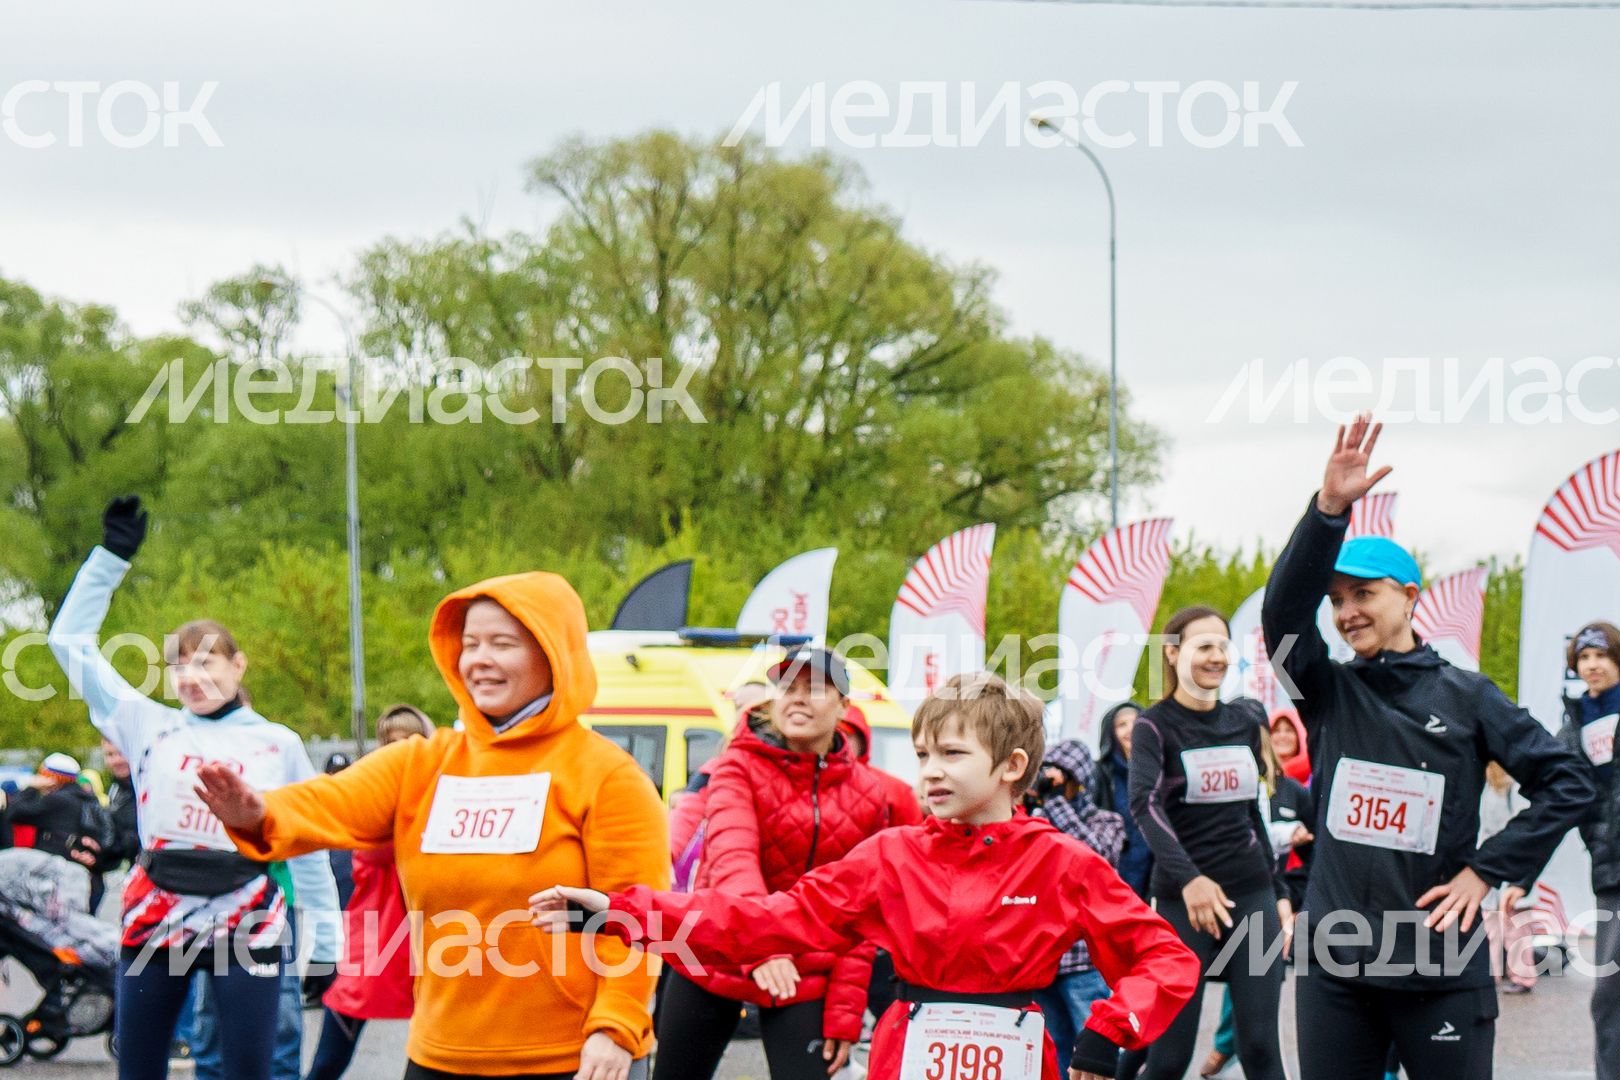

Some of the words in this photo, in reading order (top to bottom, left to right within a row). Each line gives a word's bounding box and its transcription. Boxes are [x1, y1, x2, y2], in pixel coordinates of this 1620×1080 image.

[1201, 767, 1239, 793] 3216
[450, 807, 515, 839] 3167
[1346, 793, 1408, 834] 3154
